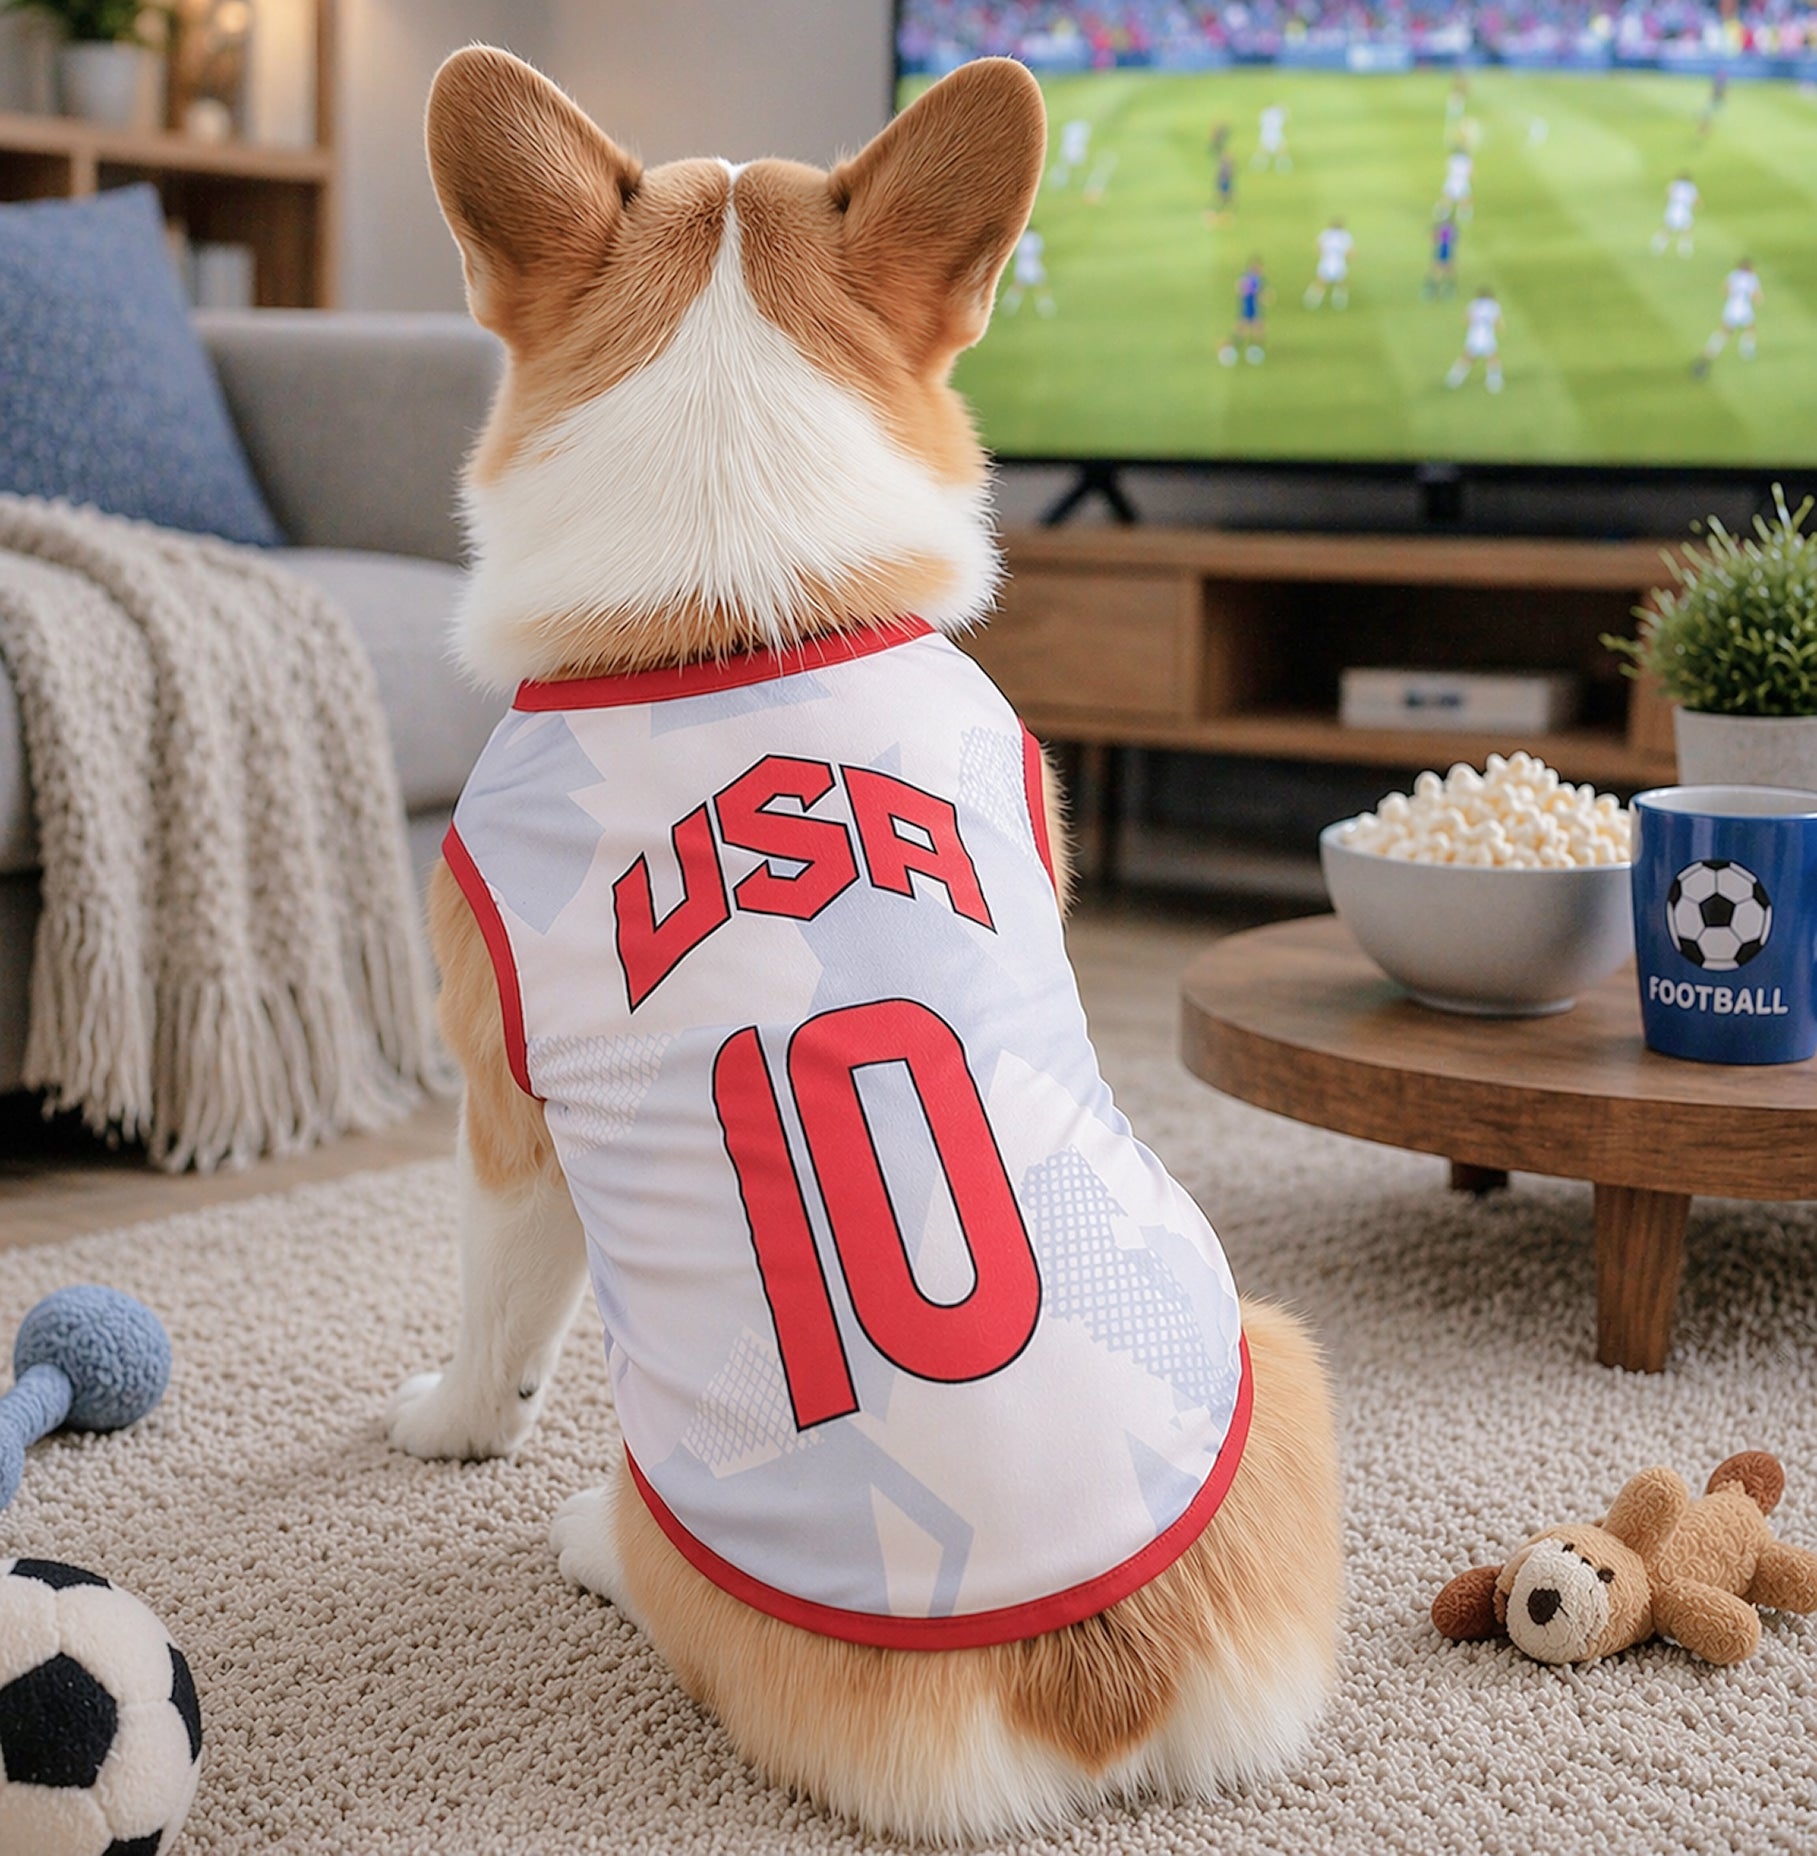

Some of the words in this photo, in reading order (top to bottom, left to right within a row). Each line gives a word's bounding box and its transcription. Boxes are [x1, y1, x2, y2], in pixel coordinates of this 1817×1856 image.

[613, 754, 998, 1013] USA
[1649, 976, 1788, 1015] FOOTBALL
[712, 998, 1042, 1432] 10
